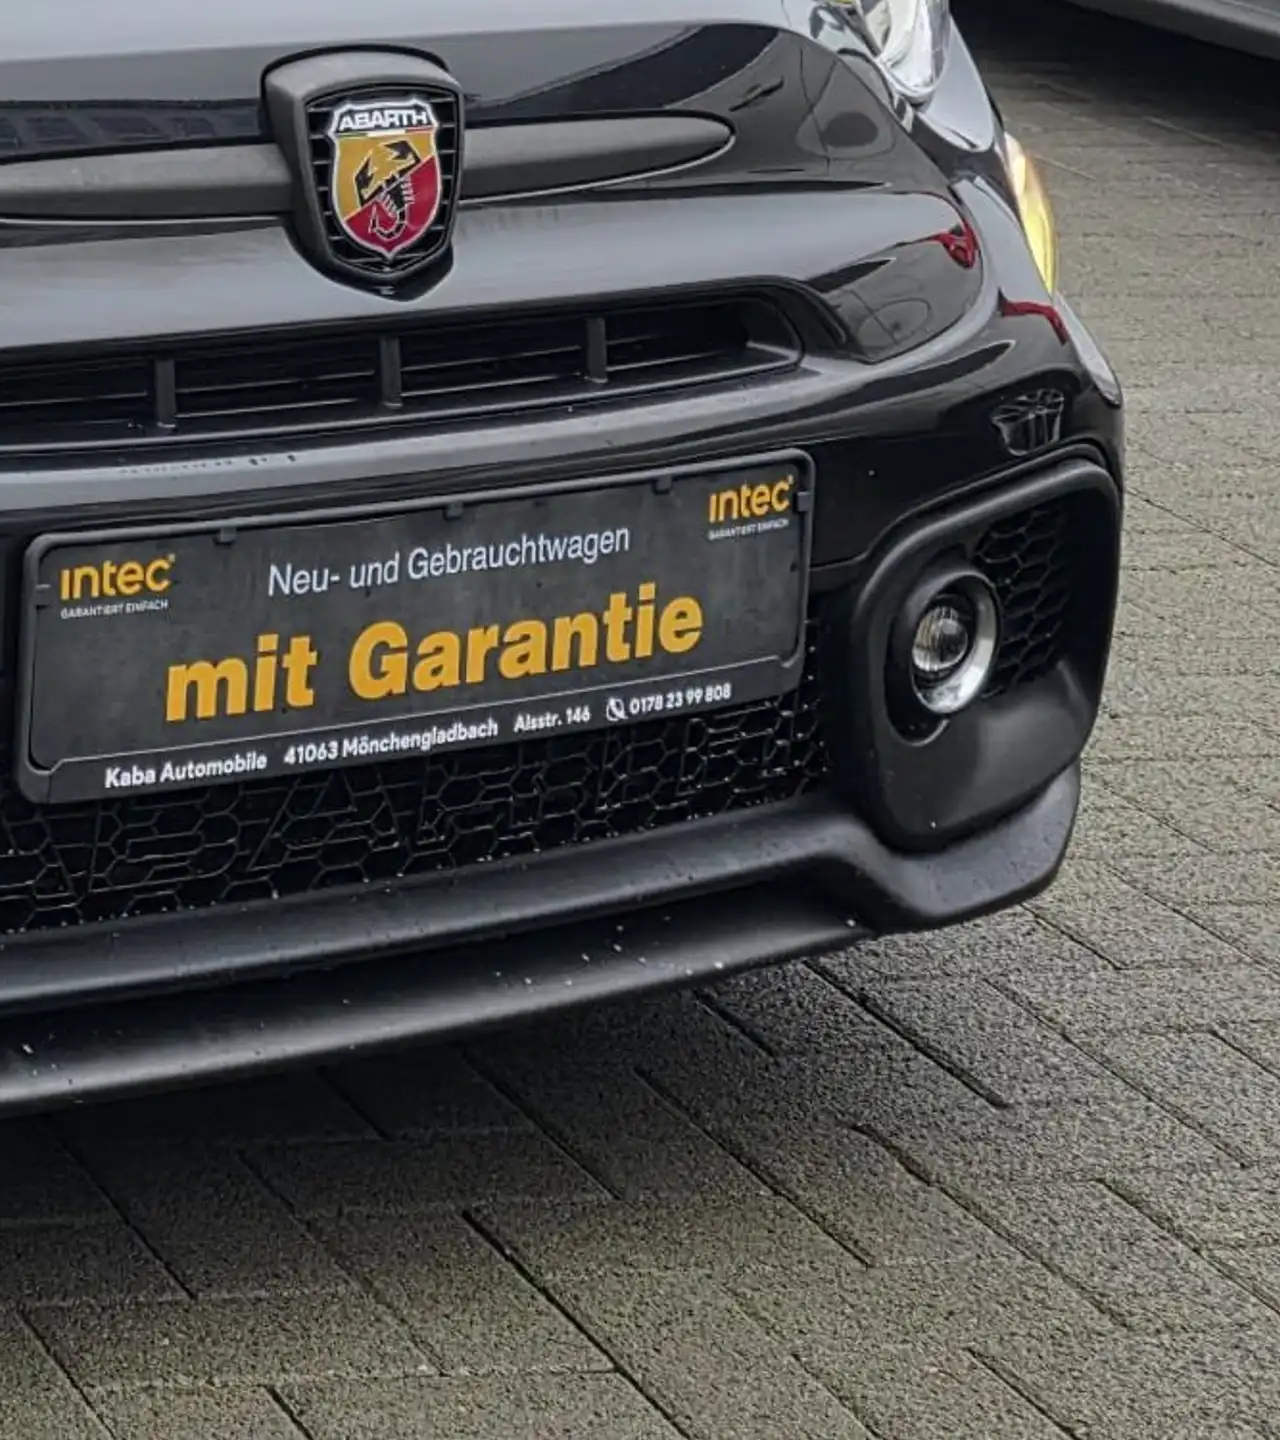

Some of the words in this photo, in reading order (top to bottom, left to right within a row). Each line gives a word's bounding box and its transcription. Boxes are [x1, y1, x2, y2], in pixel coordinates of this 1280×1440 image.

[339, 109, 428, 131] ABARTH
[708, 478, 791, 524] intec
[60, 556, 173, 601] intec
[267, 563, 340, 597] Neu-
[349, 553, 400, 589] und
[407, 527, 630, 580] Gebrauchtwagen
[126, 598, 170, 613] EINFACH
[165, 633, 318, 722] mit
[348, 582, 704, 700] Garantie
[104, 764, 157, 789] Kaba
[160, 751, 268, 782] Automobile
[284, 740, 340, 765] 41063
[342, 716, 500, 758] Mönchengladbach
[566, 705, 592, 726] 146
[628, 695, 664, 715] 0178
[665, 691, 684, 709] 23
[685, 686, 703, 705] 99
[704, 681, 733, 703] 808
